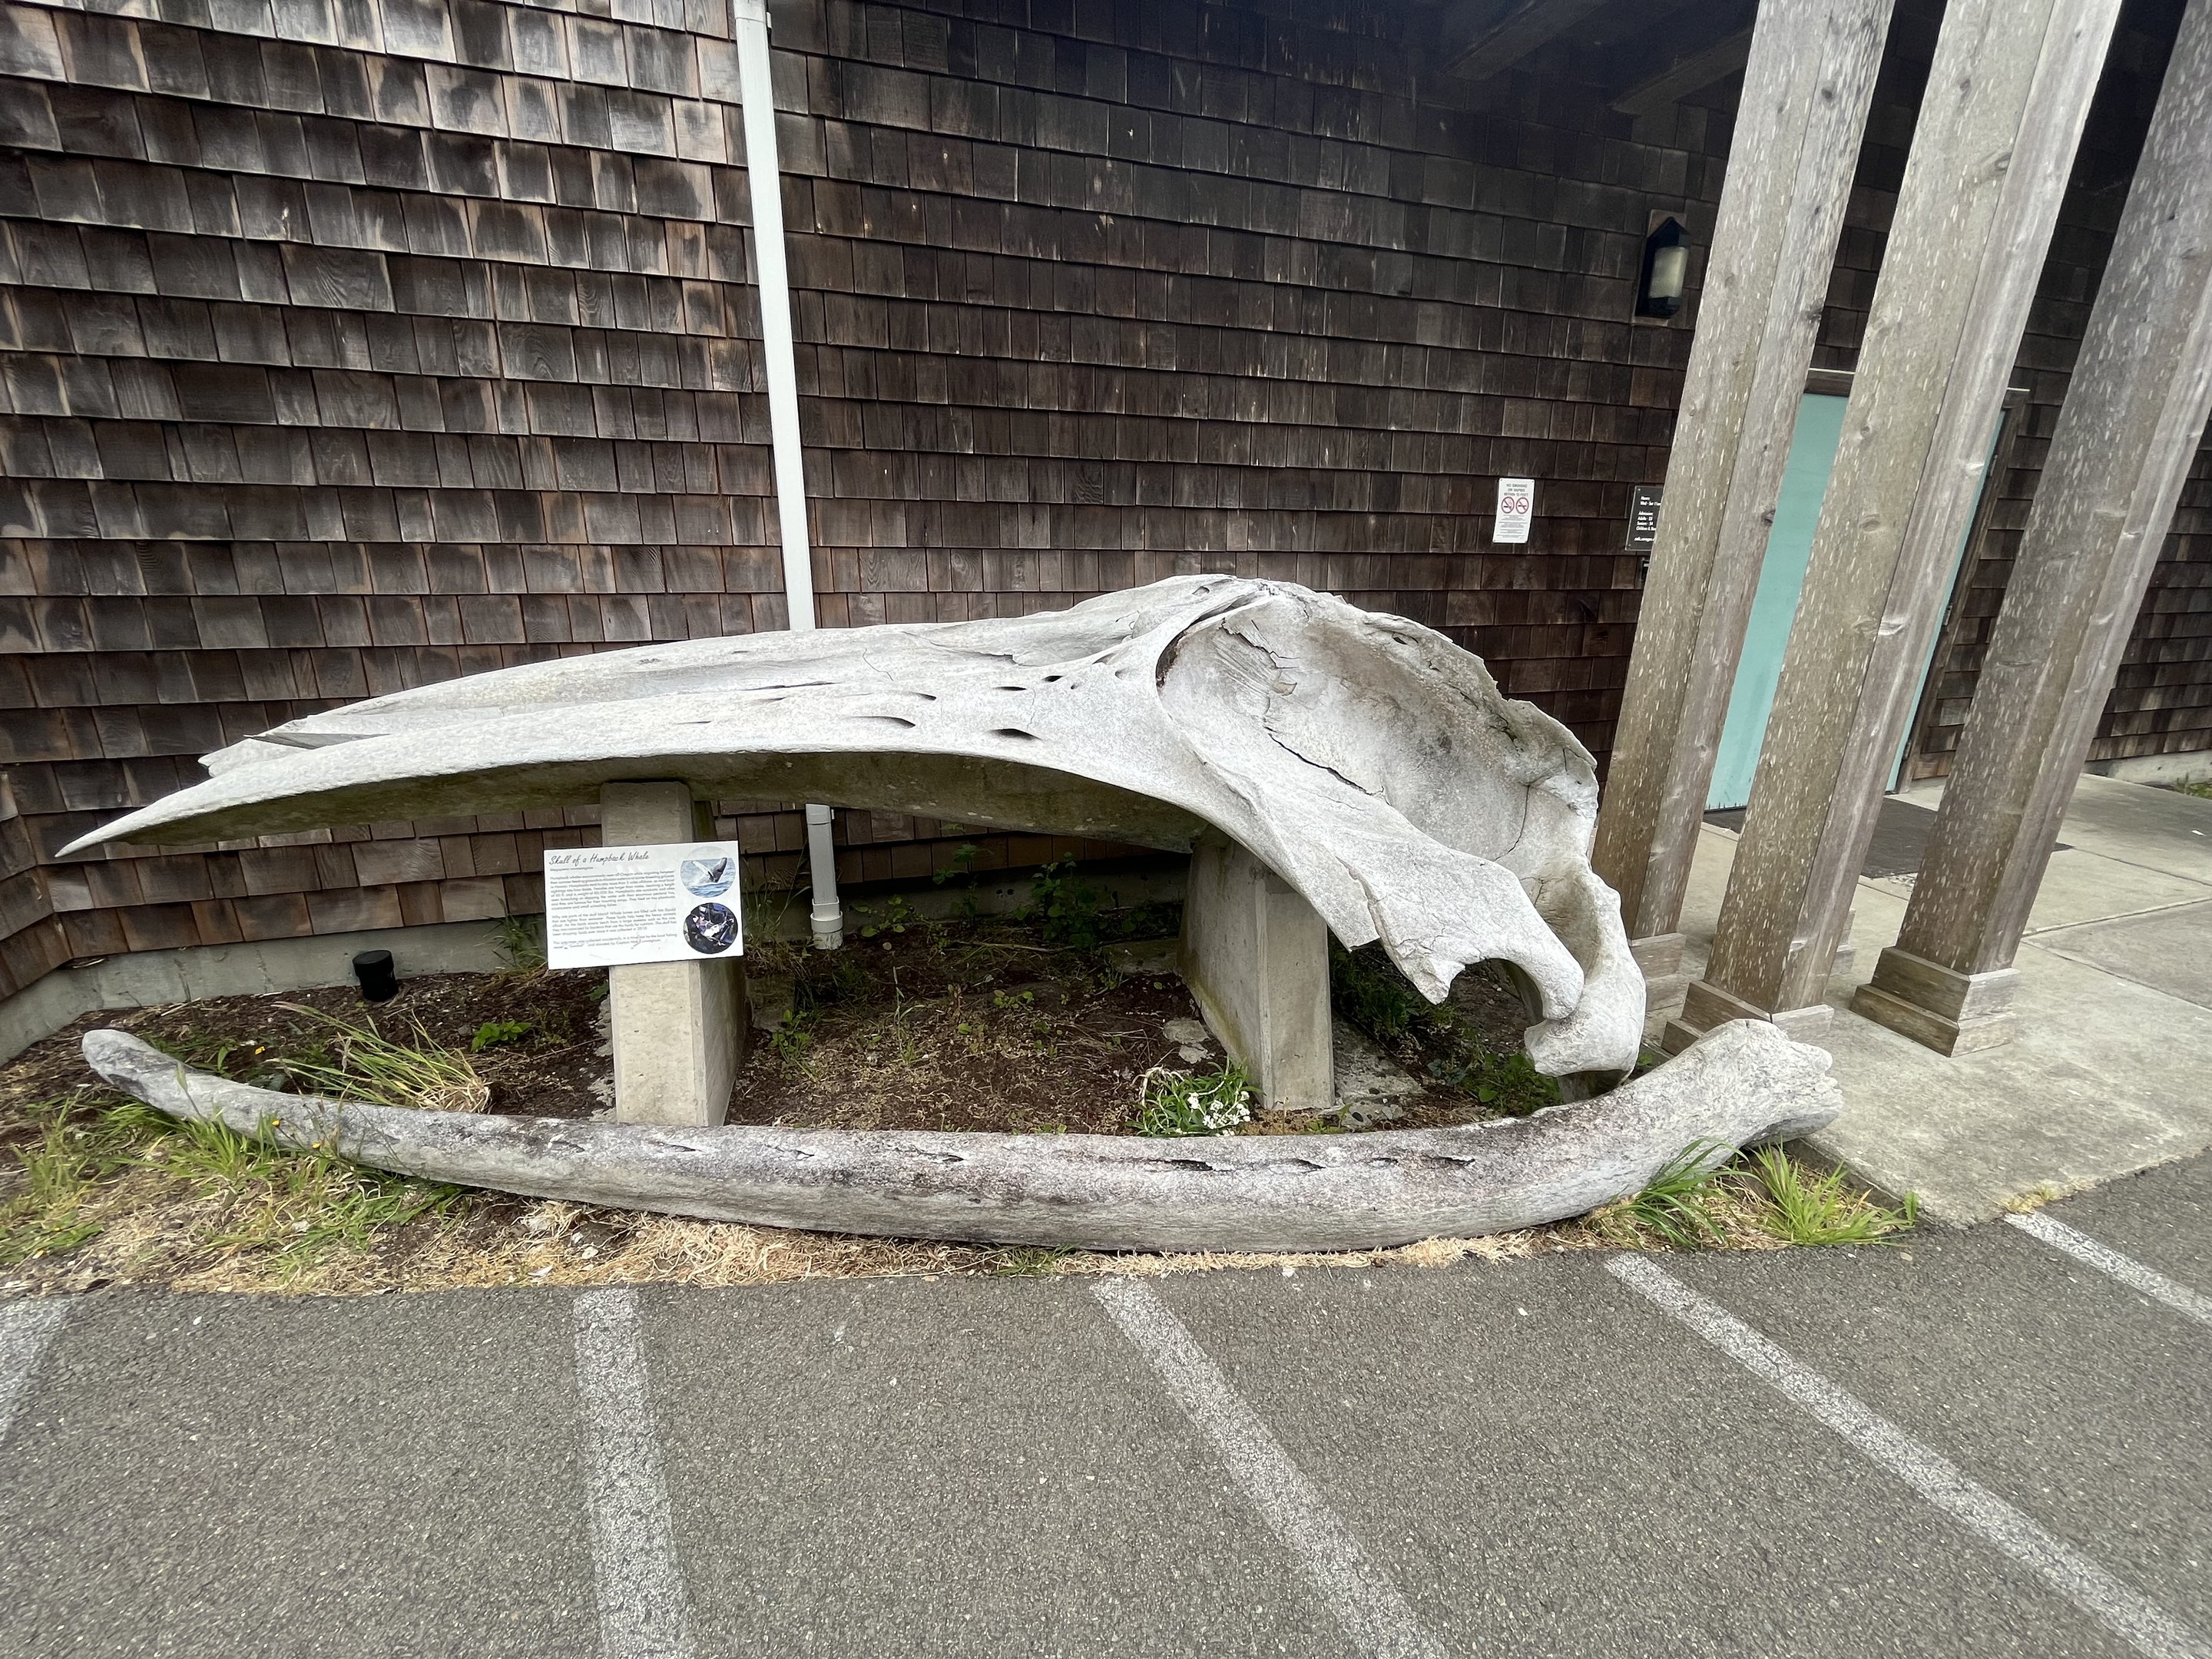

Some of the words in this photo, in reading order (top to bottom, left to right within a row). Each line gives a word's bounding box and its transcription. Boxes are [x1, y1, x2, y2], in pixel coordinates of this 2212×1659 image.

[549, 855, 571, 865] Skull
[572, 854, 580, 866] of
[590, 852, 625, 865] Humpback
[628, 851, 649, 861] Whale
